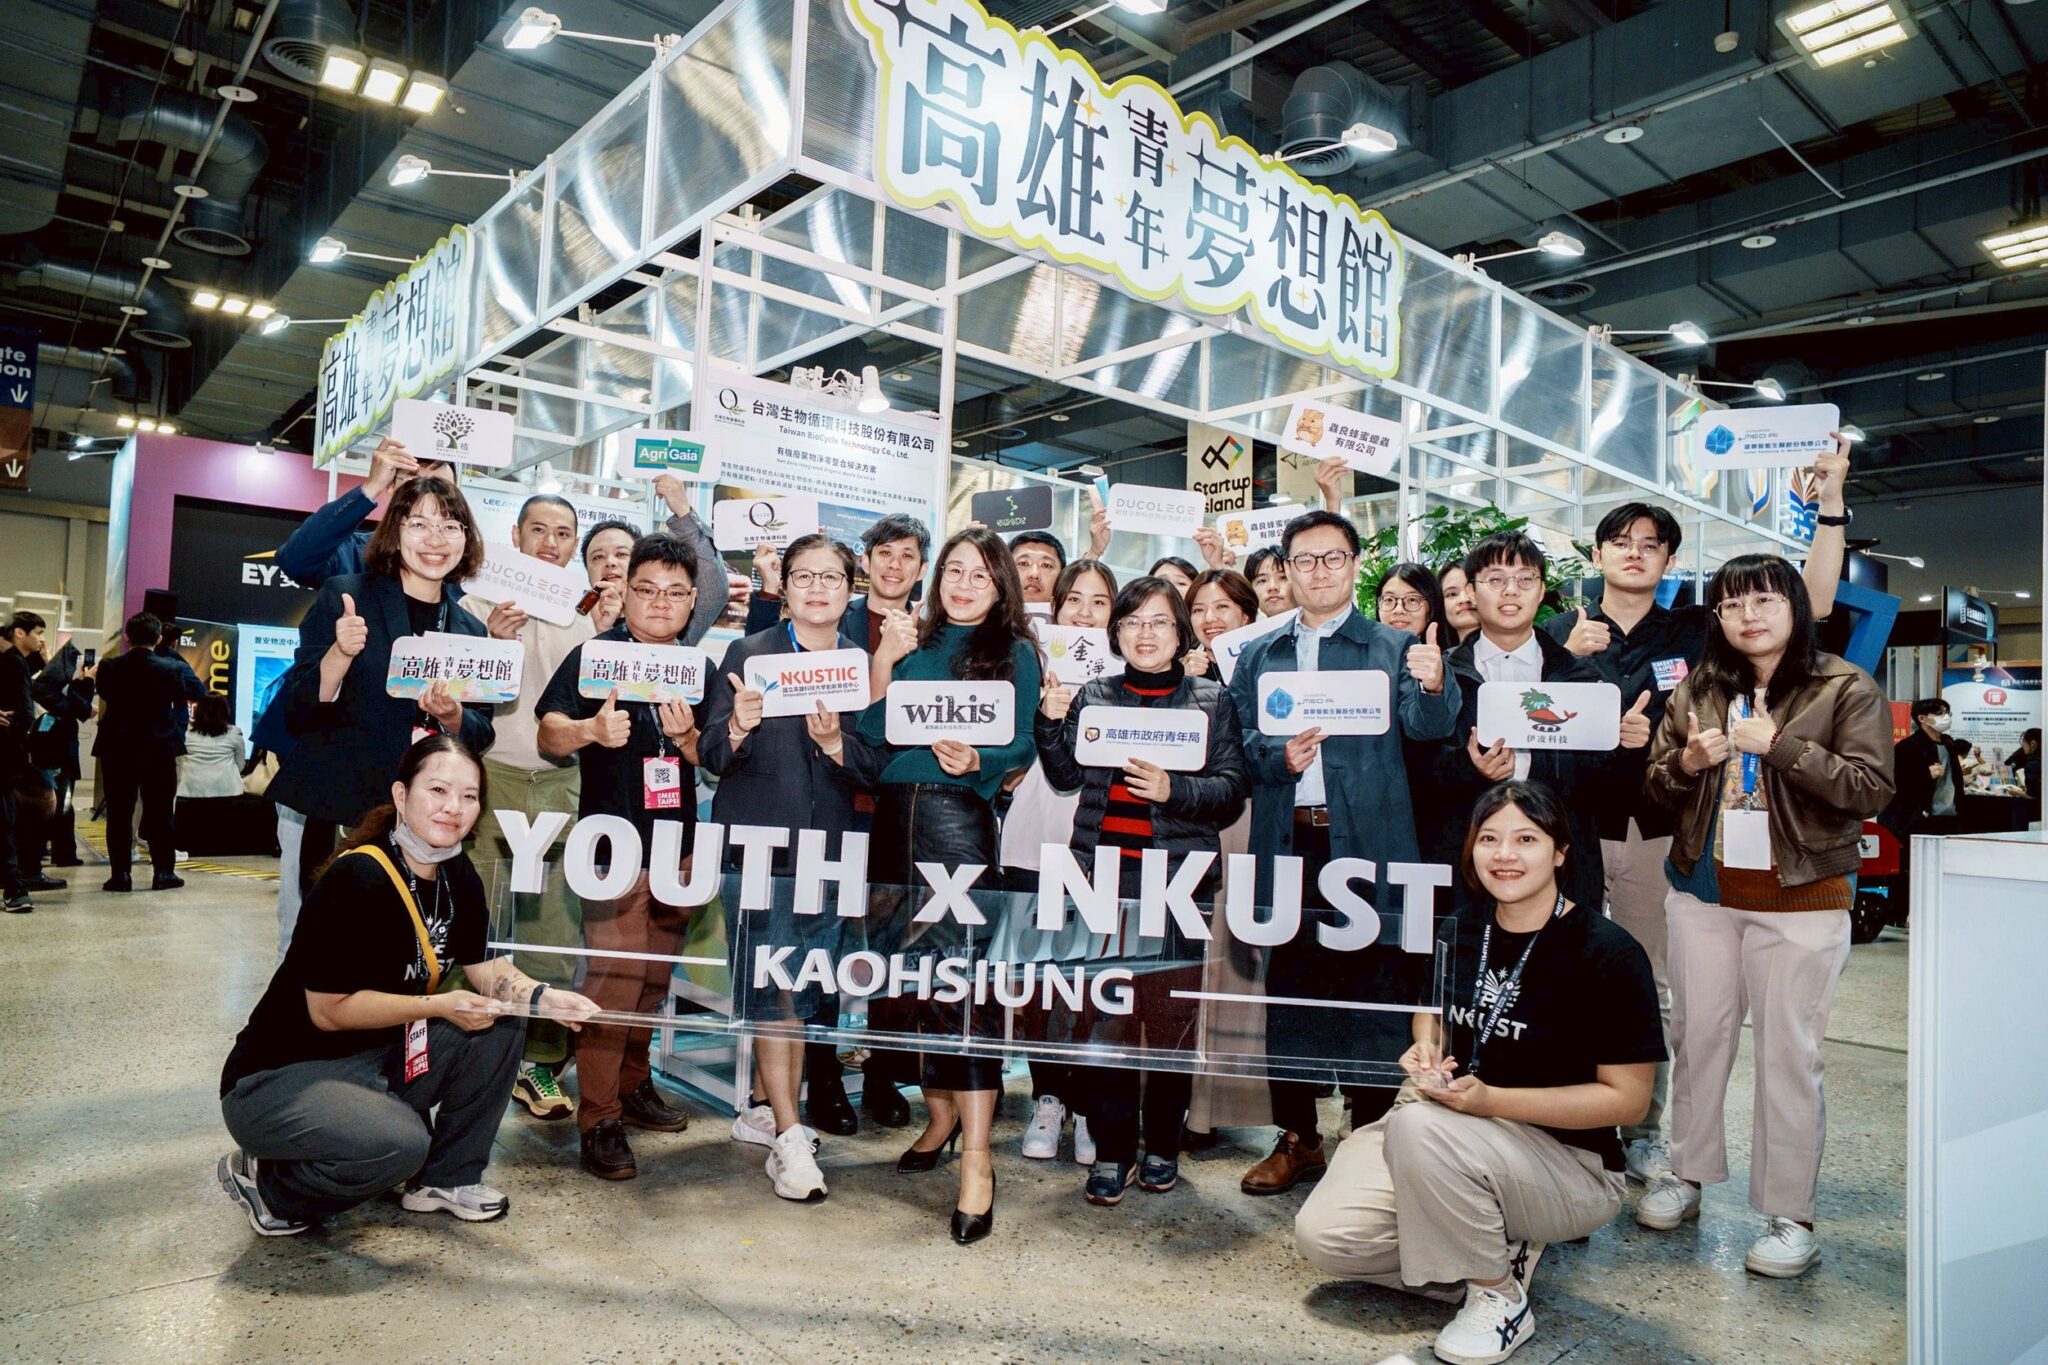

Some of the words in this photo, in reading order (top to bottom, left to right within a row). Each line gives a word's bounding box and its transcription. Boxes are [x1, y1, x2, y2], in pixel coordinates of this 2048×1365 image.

[891, 4, 1393, 360] 高雄青年夢想館
[0, 347, 26, 362] te
[752, 399, 935, 453] 台灣生物循環科技股份有限公司
[779, 425, 806, 438] Taiwan
[807, 431, 839, 444] BioCycle
[841, 438, 880, 455] Technology
[897, 450, 910, 460] Ltd.
[1335, 437, 1376, 456] 有限公司
[1194, 476, 1250, 498] Startup
[574, 508, 627, 522] 份有限公司
[242, 562, 280, 586] EY
[401, 655, 514, 681] 高雄青年夢想館
[591, 657, 698, 686] 高雄青年夢想館
[780, 666, 858, 685] NKUSTIIC
[901, 694, 996, 725] wikis
[1105, 728, 1200, 743] 高雄市政府青年局
[493, 809, 869, 917] YOUTH
[913, 862, 988, 925] x
[1036, 843, 1453, 954] NKUST
[753, 945, 1134, 1016] KAOHSIUNG
[410, 1027, 426, 1043] STAFF
